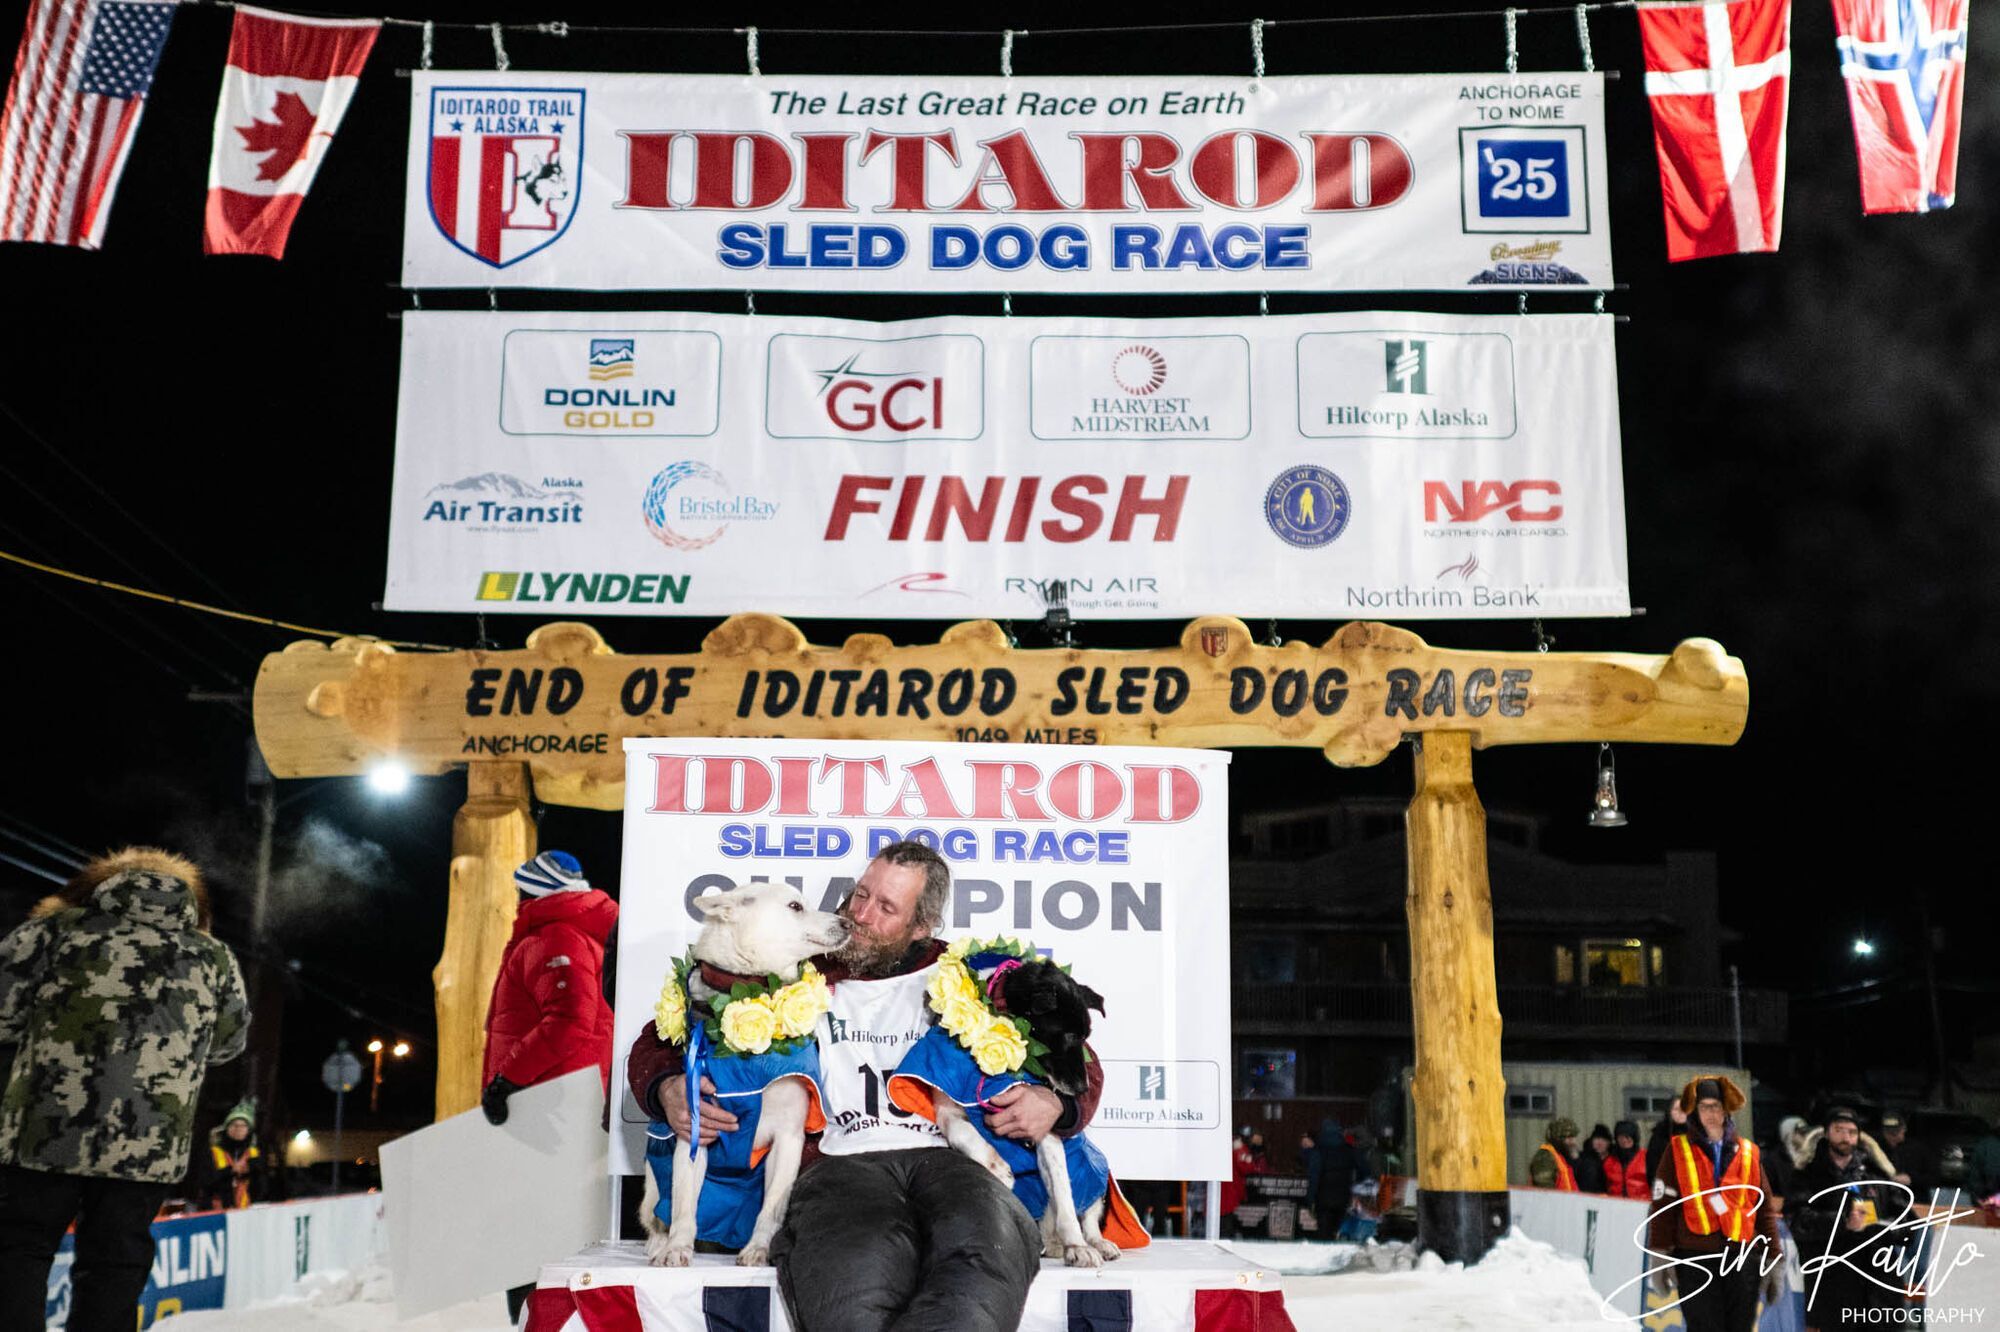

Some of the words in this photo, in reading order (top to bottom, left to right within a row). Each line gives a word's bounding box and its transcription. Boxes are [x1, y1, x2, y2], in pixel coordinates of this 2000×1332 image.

[770, 90, 827, 115] The
[837, 90, 908, 116] Last
[918, 90, 1008, 116] Great
[1016, 91, 1097, 116] Race
[1107, 96, 1148, 115] on
[1159, 91, 1246, 115] Earth
[1458, 84, 1582, 100] ANCHORAGE
[440, 98, 521, 116] IDITAROD
[528, 99, 575, 116] TRAIL
[1477, 106, 1502, 120] TO
[1509, 104, 1565, 119] NOME
[474, 117, 540, 133] ALASKA
[613, 127, 1415, 213] IDITAROD
[717, 222, 909, 271] SLED
[929, 222, 1092, 272] DOG
[1112, 222, 1312, 271] RACE
[1496, 262, 1561, 280] SIGNS
[544, 388, 676, 407] DONLIN
[826, 377, 944, 432] GCI
[1092, 398, 1191, 414] HARVEST
[564, 410, 655, 429] GOLD
[1072, 415, 1211, 433] MIDSTREAM
[1326, 405, 1409, 430] Hilcorp
[1415, 407, 1489, 427] Alaska
[542, 477, 584, 489] Alaska
[423, 500, 472, 522] Air
[478, 500, 584, 523] Transit
[679, 496, 740, 514] Bristol
[744, 496, 781, 520] Bay
[823, 473, 1192, 544] FINISH
[1423, 479, 1564, 523] NAC
[516, 572, 692, 603] LYNDEN
[1006, 578, 1093, 593] RYN
[1106, 578, 1159, 593] AIR
[1347, 584, 1463, 608] Northrim
[1473, 584, 1541, 608] Bank
[466, 666, 584, 718] END
[620, 666, 696, 718] OF
[736, 667, 1017, 720] IDITAROD
[1049, 665, 1191, 717] SLED
[1229, 667, 1350, 718] DOG
[1385, 668, 1534, 722] RACE
[462, 733, 610, 756] ANCHORAGE
[956, 727, 1009, 743] 1049
[1023, 728, 1098, 745] MILES
[645, 753, 1203, 825] IDITAROD
[718, 822, 853, 859] SLED
[992, 828, 1131, 865] RACE
[684, 874, 1162, 931] CPION
[851, 1030, 899, 1046] Hilcorp
[1103, 1107, 1155, 1123] Hilcorp
[1158, 1108, 1204, 1121] Alaska
